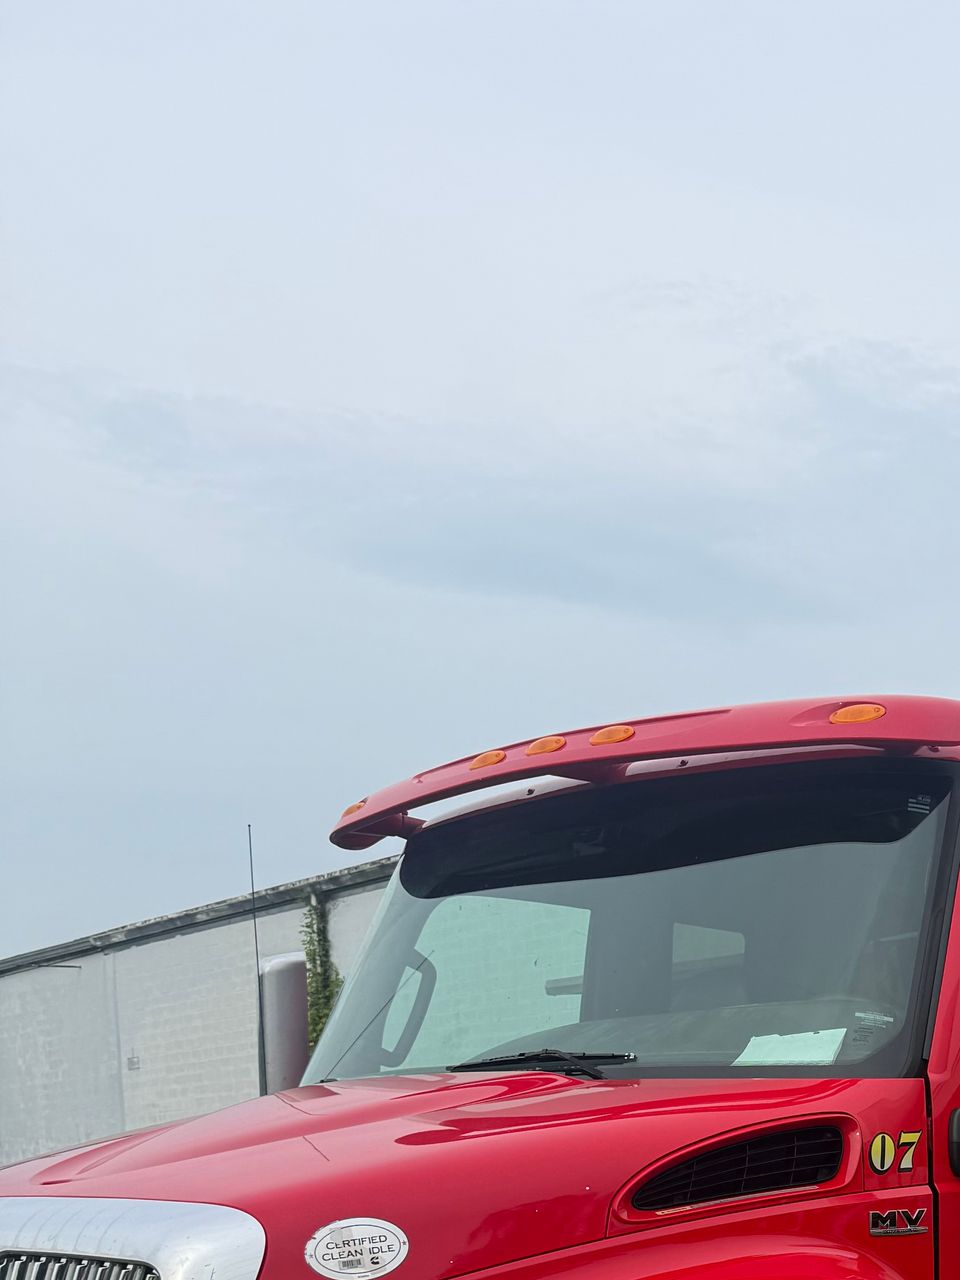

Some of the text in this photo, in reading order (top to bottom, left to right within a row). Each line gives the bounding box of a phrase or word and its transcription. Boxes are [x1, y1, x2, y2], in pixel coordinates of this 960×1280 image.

[867, 1129, 922, 1176] 07
[869, 1208, 927, 1231] MV
[321, 1243, 396, 1262] CLEAN IDLE
[325, 1234, 388, 1251] CERTIFIED
